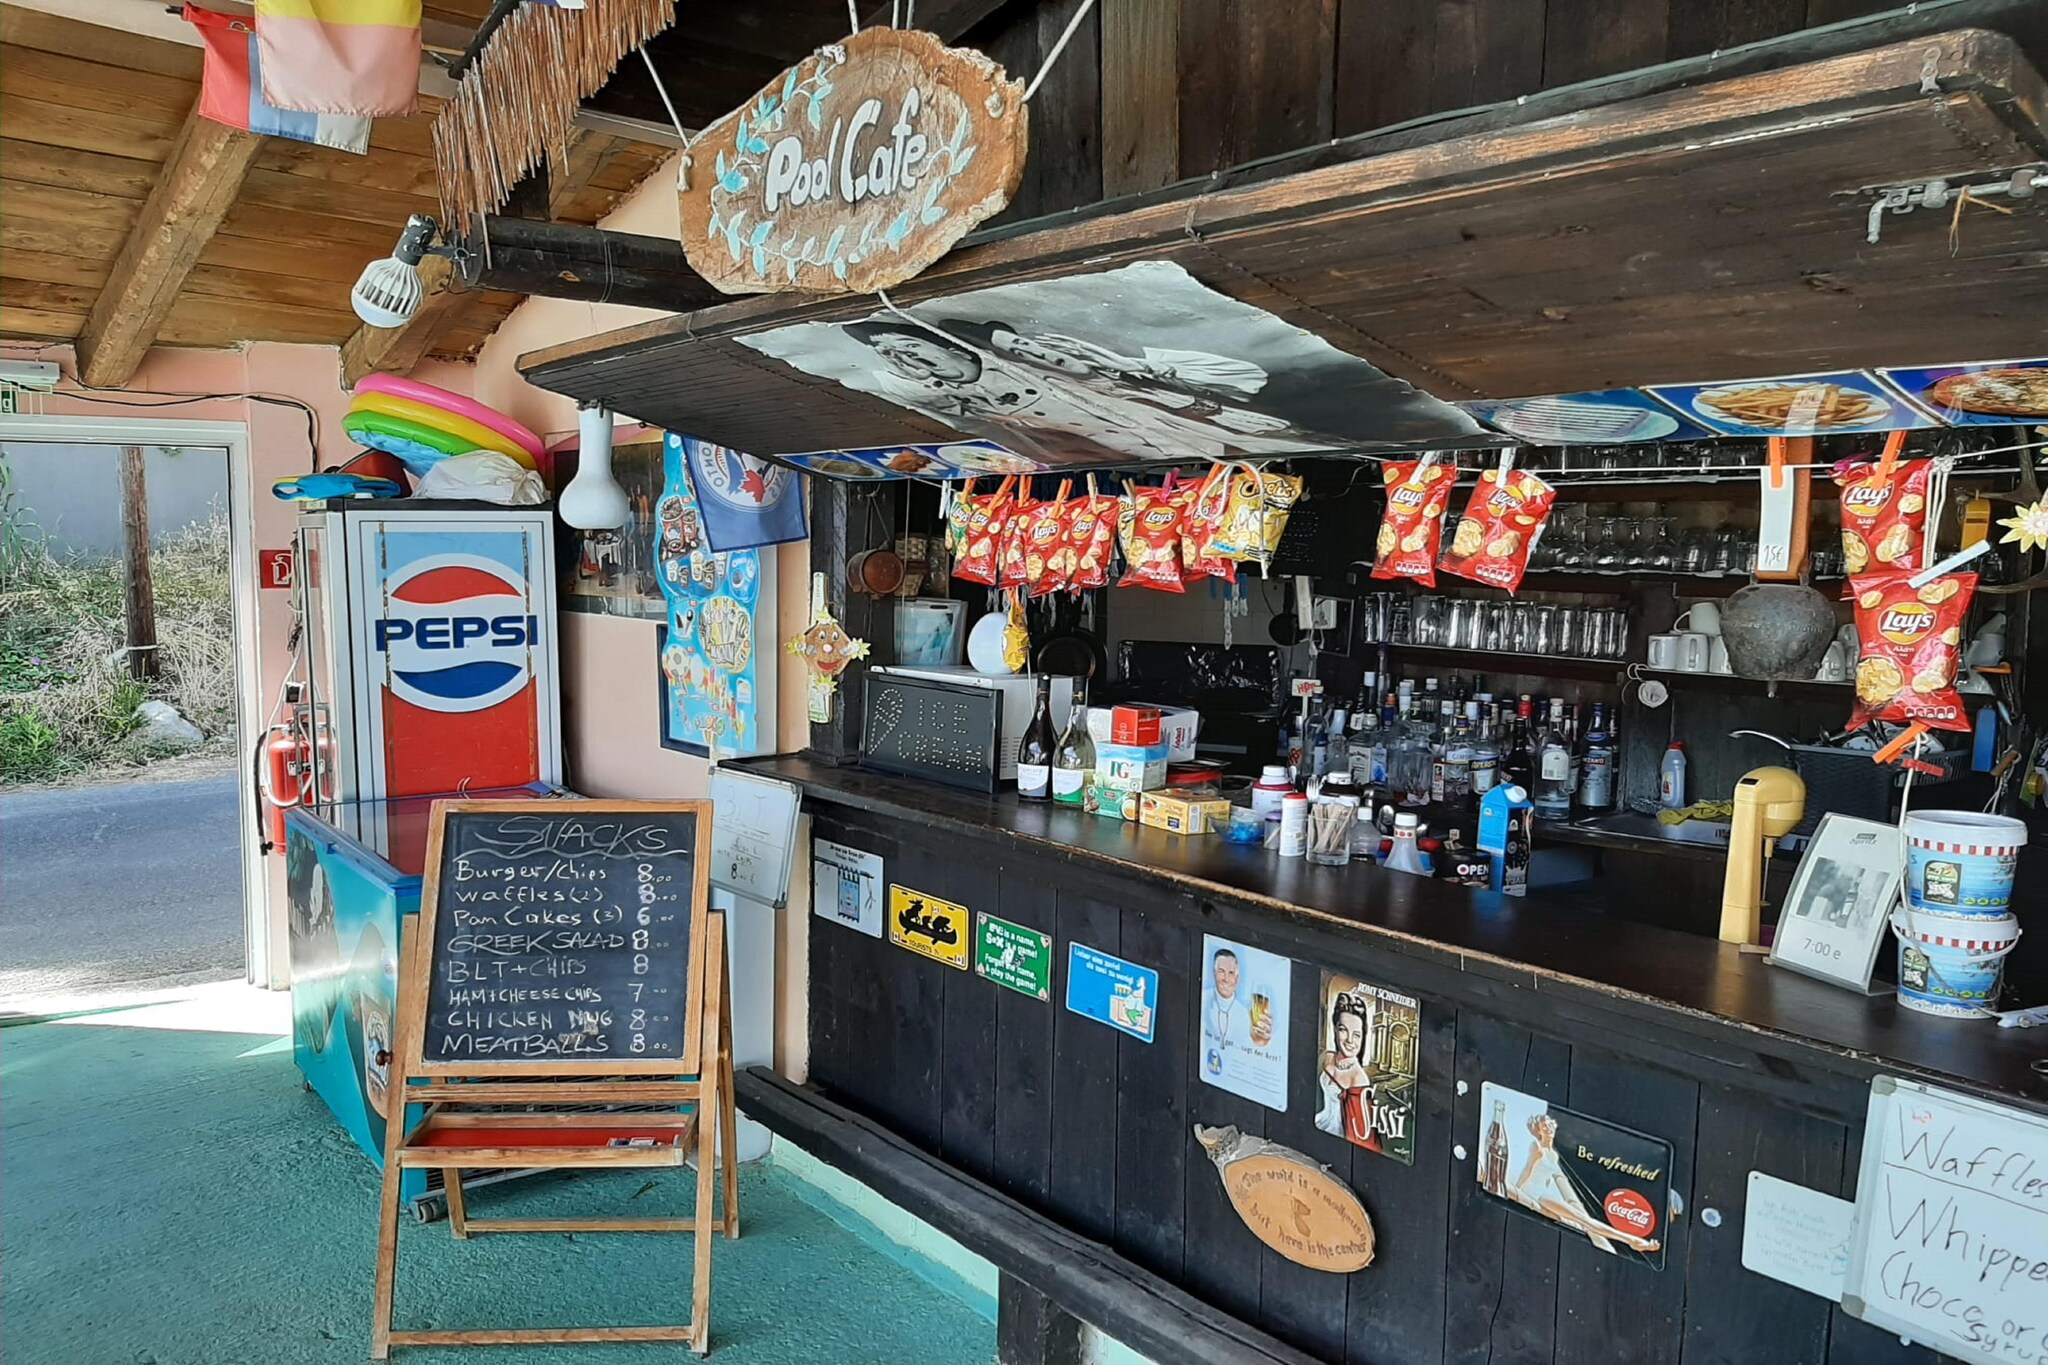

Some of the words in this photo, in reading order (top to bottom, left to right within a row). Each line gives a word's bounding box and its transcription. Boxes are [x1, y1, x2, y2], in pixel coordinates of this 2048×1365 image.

[765, 116, 841, 212] Pool
[1145, 508, 1176, 523] Lay's
[375, 615, 538, 652] PEPSI
[1882, 611, 1933, 634] Lay's
[919, 699, 968, 734] ICE
[898, 731, 982, 774] CREAM
[453, 910, 497, 926] Pan
[505, 906, 582, 925] Cakes
[593, 905, 623, 924] (3)
[447, 931, 552, 955] GREEK
[552, 932, 625, 951] SALAD
[1803, 937, 1831, 958] 7:00
[633, 954, 649, 975] 8
[565, 984, 602, 1003] CHIPS
[1377, 987, 1417, 1009] SCHNEIDER
[448, 1010, 553, 1031] CHICKEN
[441, 1034, 609, 1056] MEATBALLS
[1352, 1085, 1406, 1140] Sissi
[1577, 1145, 1594, 1161] Be
[1598, 1156, 1661, 1180] refreshed
[1898, 1103, 2048, 1199] Waffles
